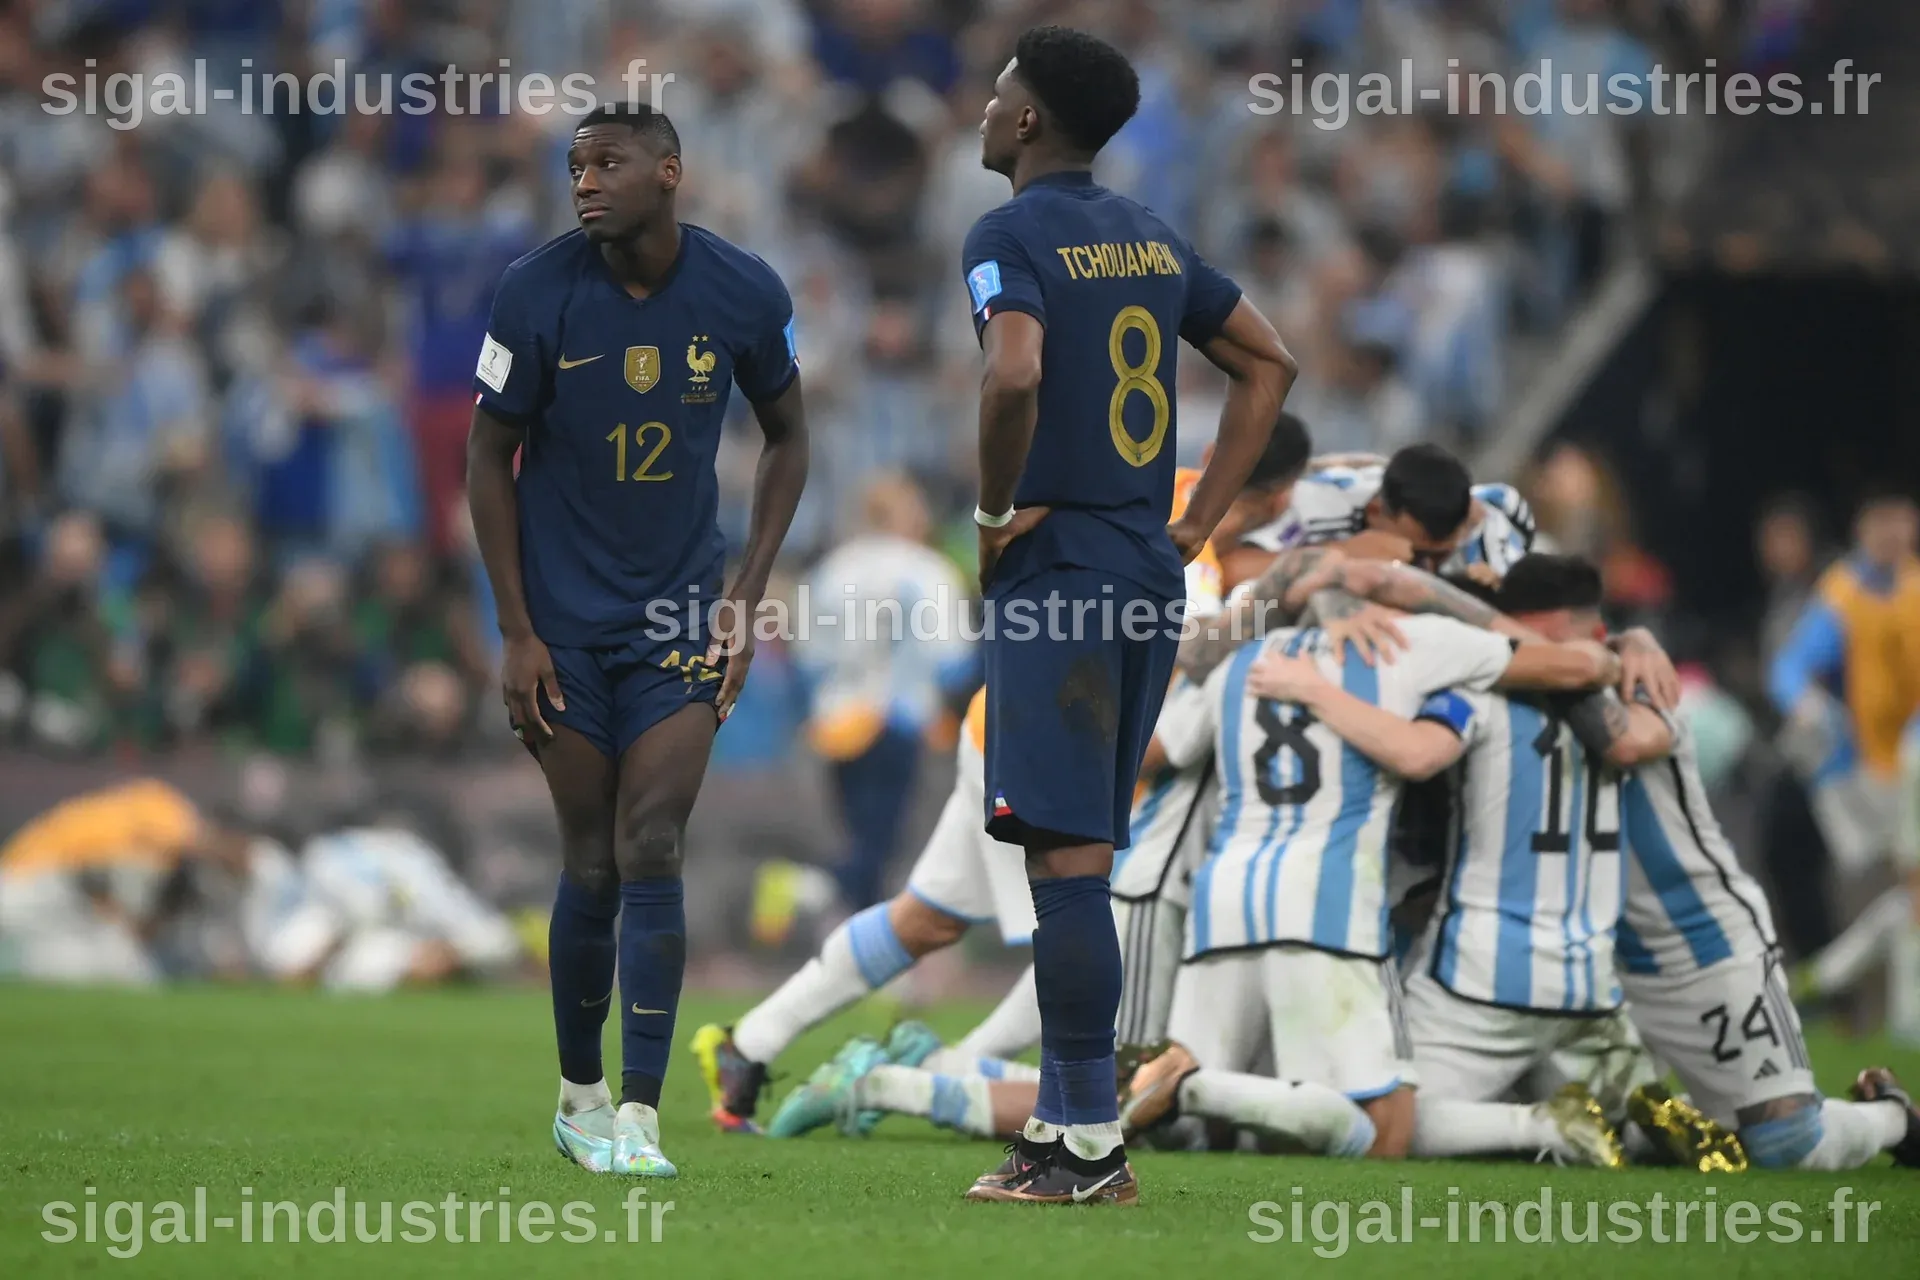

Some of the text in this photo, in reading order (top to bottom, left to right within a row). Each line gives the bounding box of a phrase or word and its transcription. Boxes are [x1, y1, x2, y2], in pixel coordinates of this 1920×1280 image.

[1109, 305, 1169, 467] 8
[606, 421, 674, 482] 12
[1254, 695, 1322, 807] 8
[1700, 994, 1780, 1063] 24
